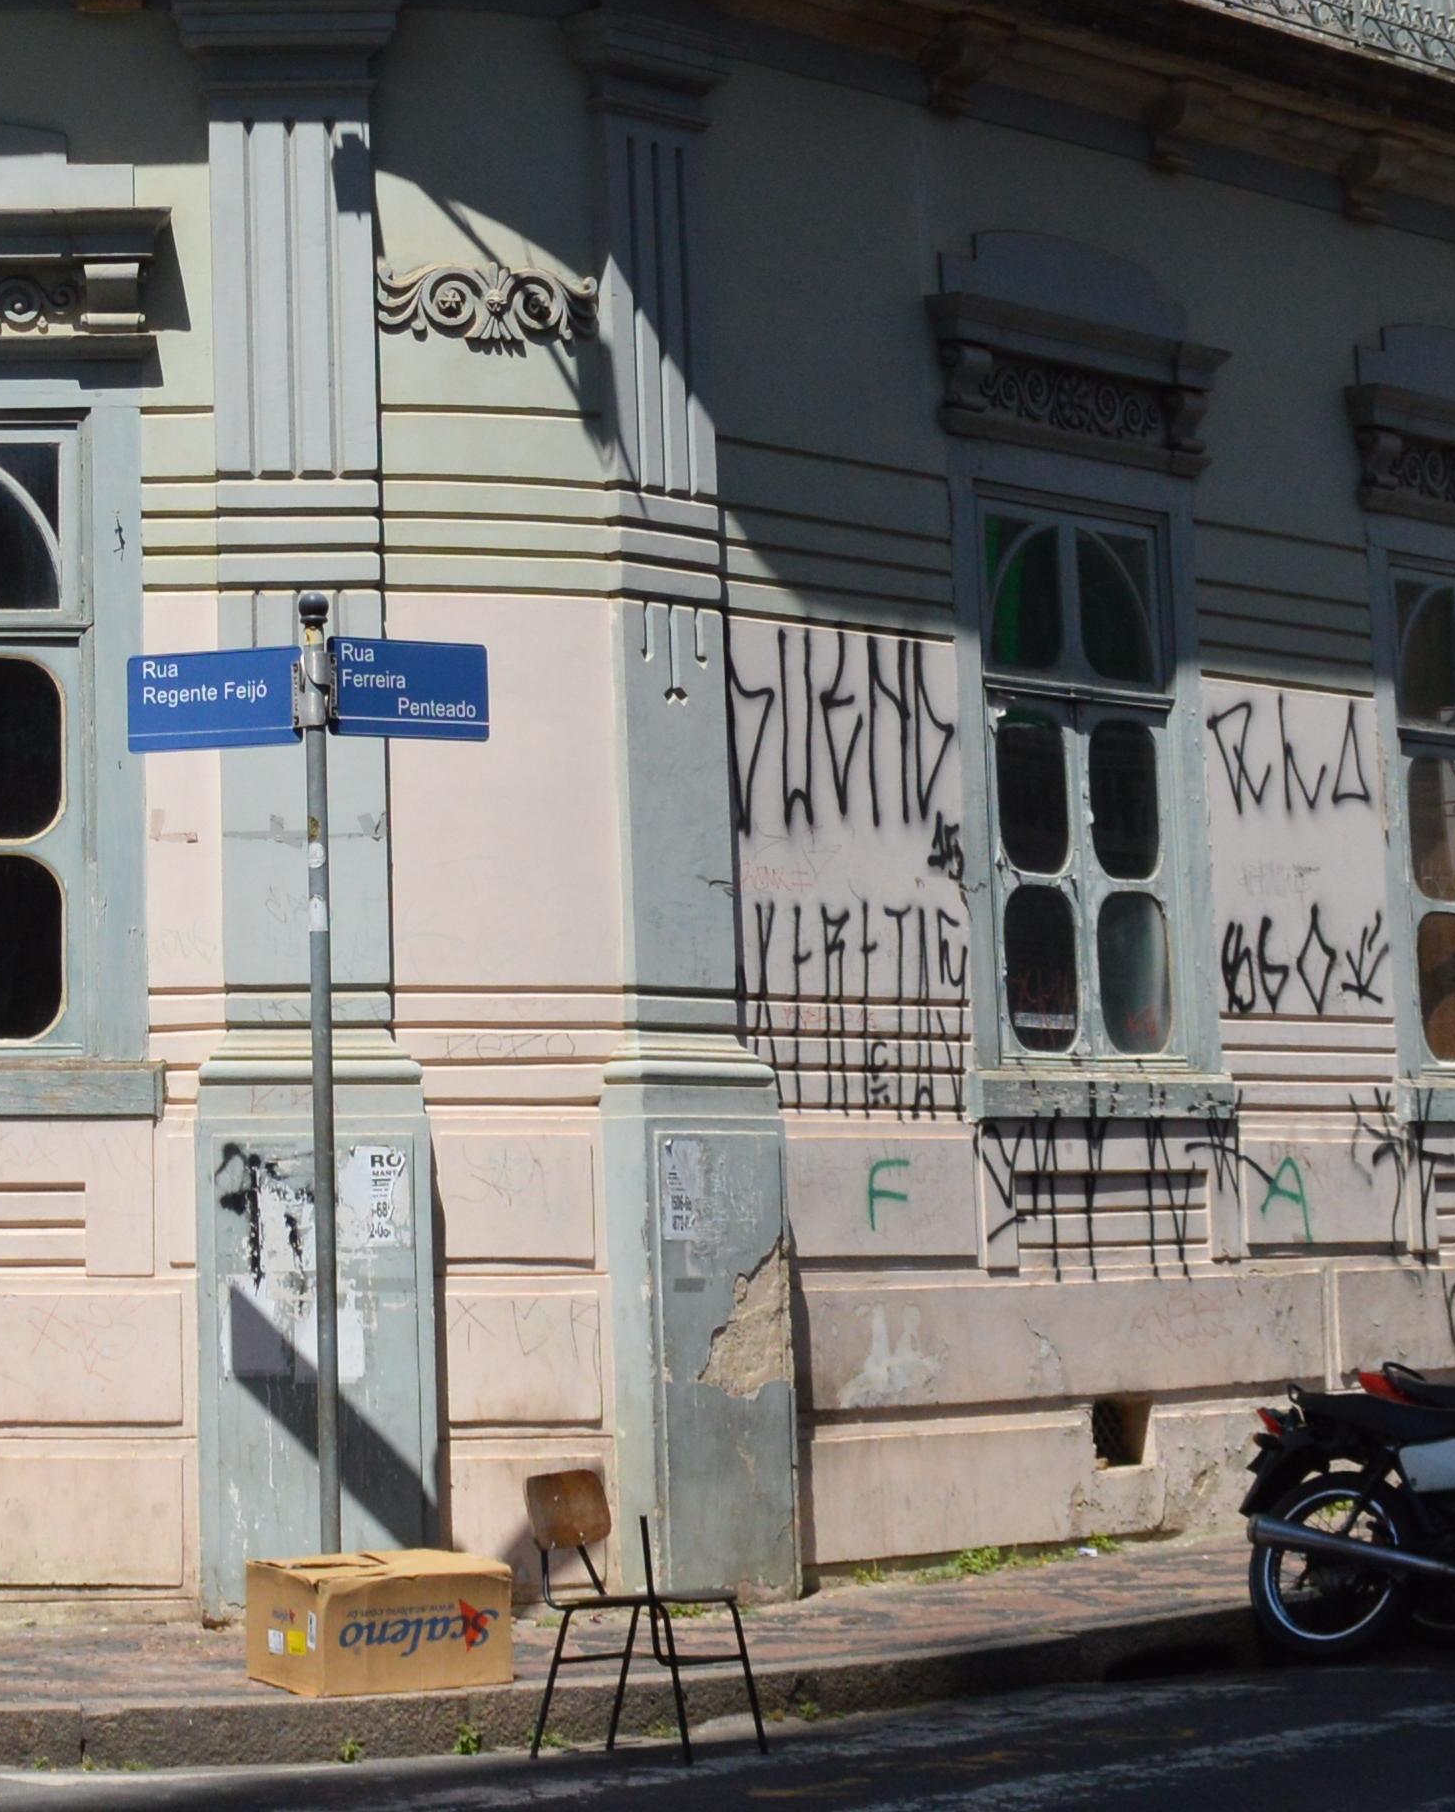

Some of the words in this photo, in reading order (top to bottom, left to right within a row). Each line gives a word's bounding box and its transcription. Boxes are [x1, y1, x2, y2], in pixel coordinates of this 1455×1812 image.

[341, 644, 374, 663] Rua
[142, 661, 178, 679] Rua
[342, 670, 406, 689] Ferreira
[142, 686, 218, 707] Regente
[224, 681, 268, 704] Feijó
[398, 698, 476, 719] Penteado
[338, 1608, 500, 1658] Scaleno
